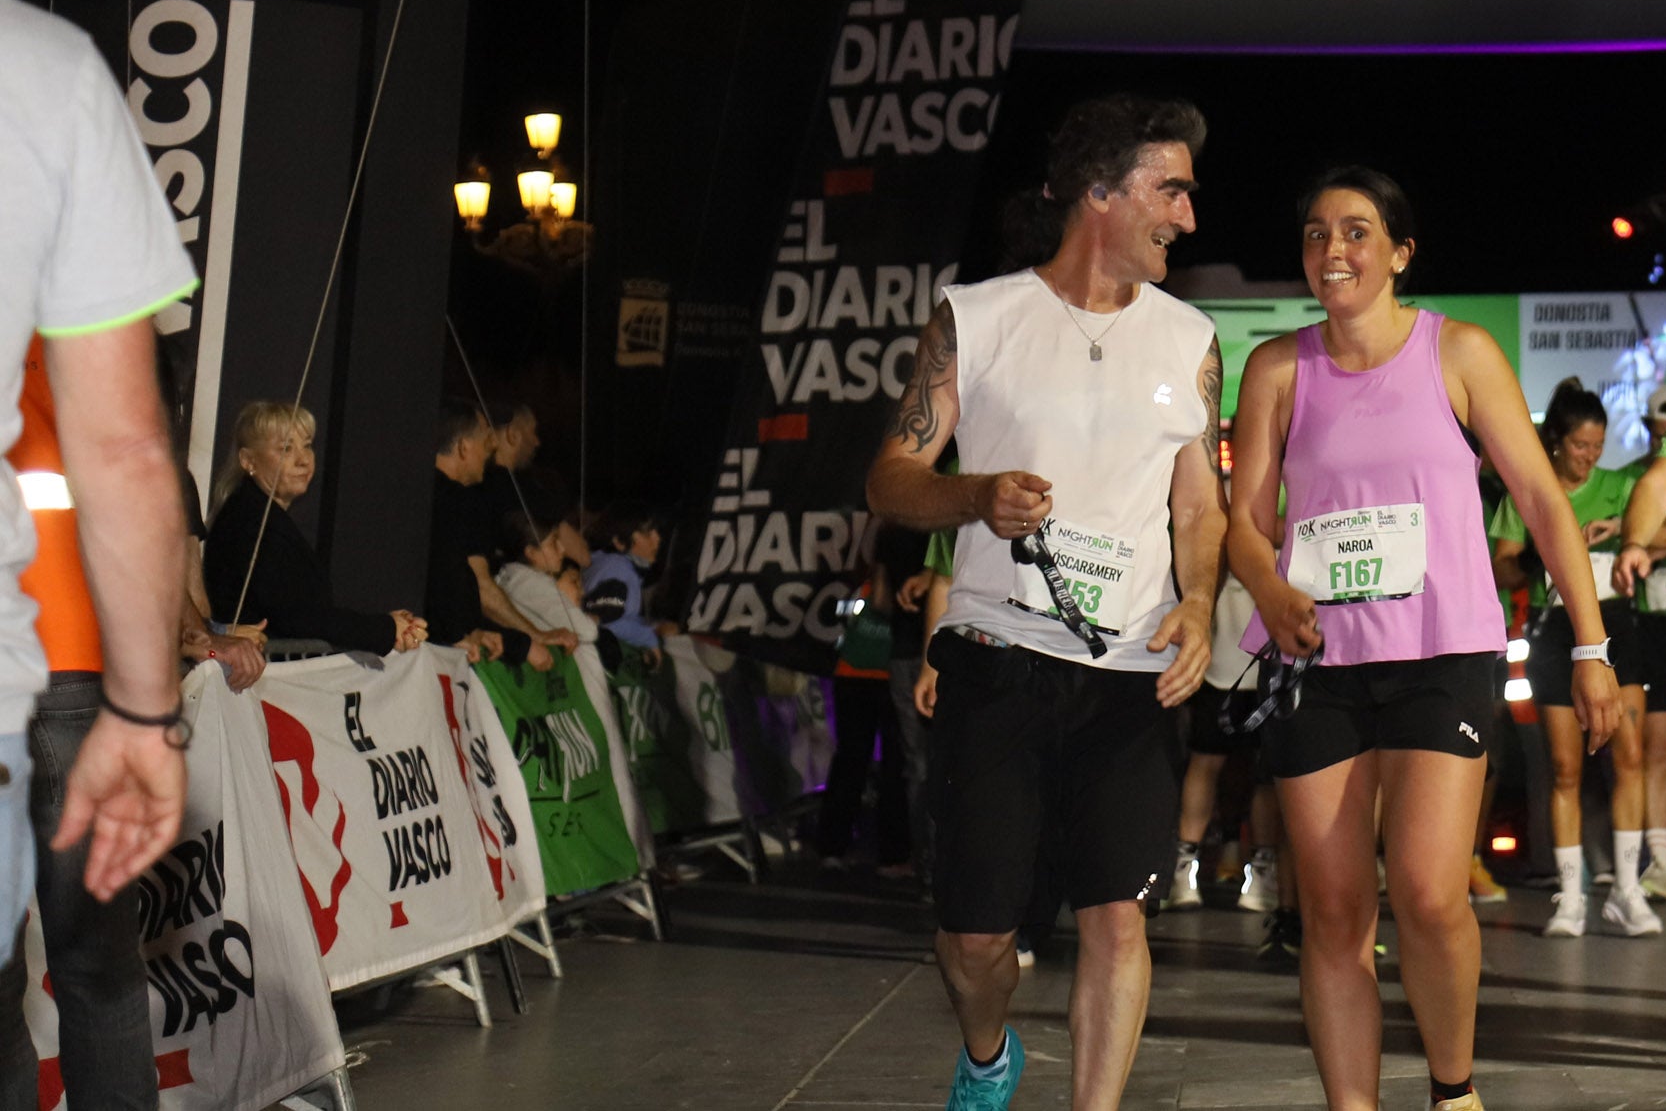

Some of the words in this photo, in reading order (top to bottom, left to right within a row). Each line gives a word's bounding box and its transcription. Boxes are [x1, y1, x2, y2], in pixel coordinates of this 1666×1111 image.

[828, 88, 1001, 158] VASC
[1533, 302, 1611, 323] DONOSTIA
[1529, 330, 1561, 351] SAN
[760, 336, 920, 405] VASC
[1298, 519, 1317, 537] 10K
[1410, 512, 1419, 527] 3
[1337, 539, 1374, 554] NAROA
[1052, 549, 1124, 583] ÓSCAR&MERY
[1329, 557, 1383, 590] F167
[688, 581, 845, 643] VASC
[344, 691, 377, 752] EL
[1459, 721, 1480, 744] FILA
[366, 745, 439, 820] DIARIO
[382, 814, 451, 892] VASCO
